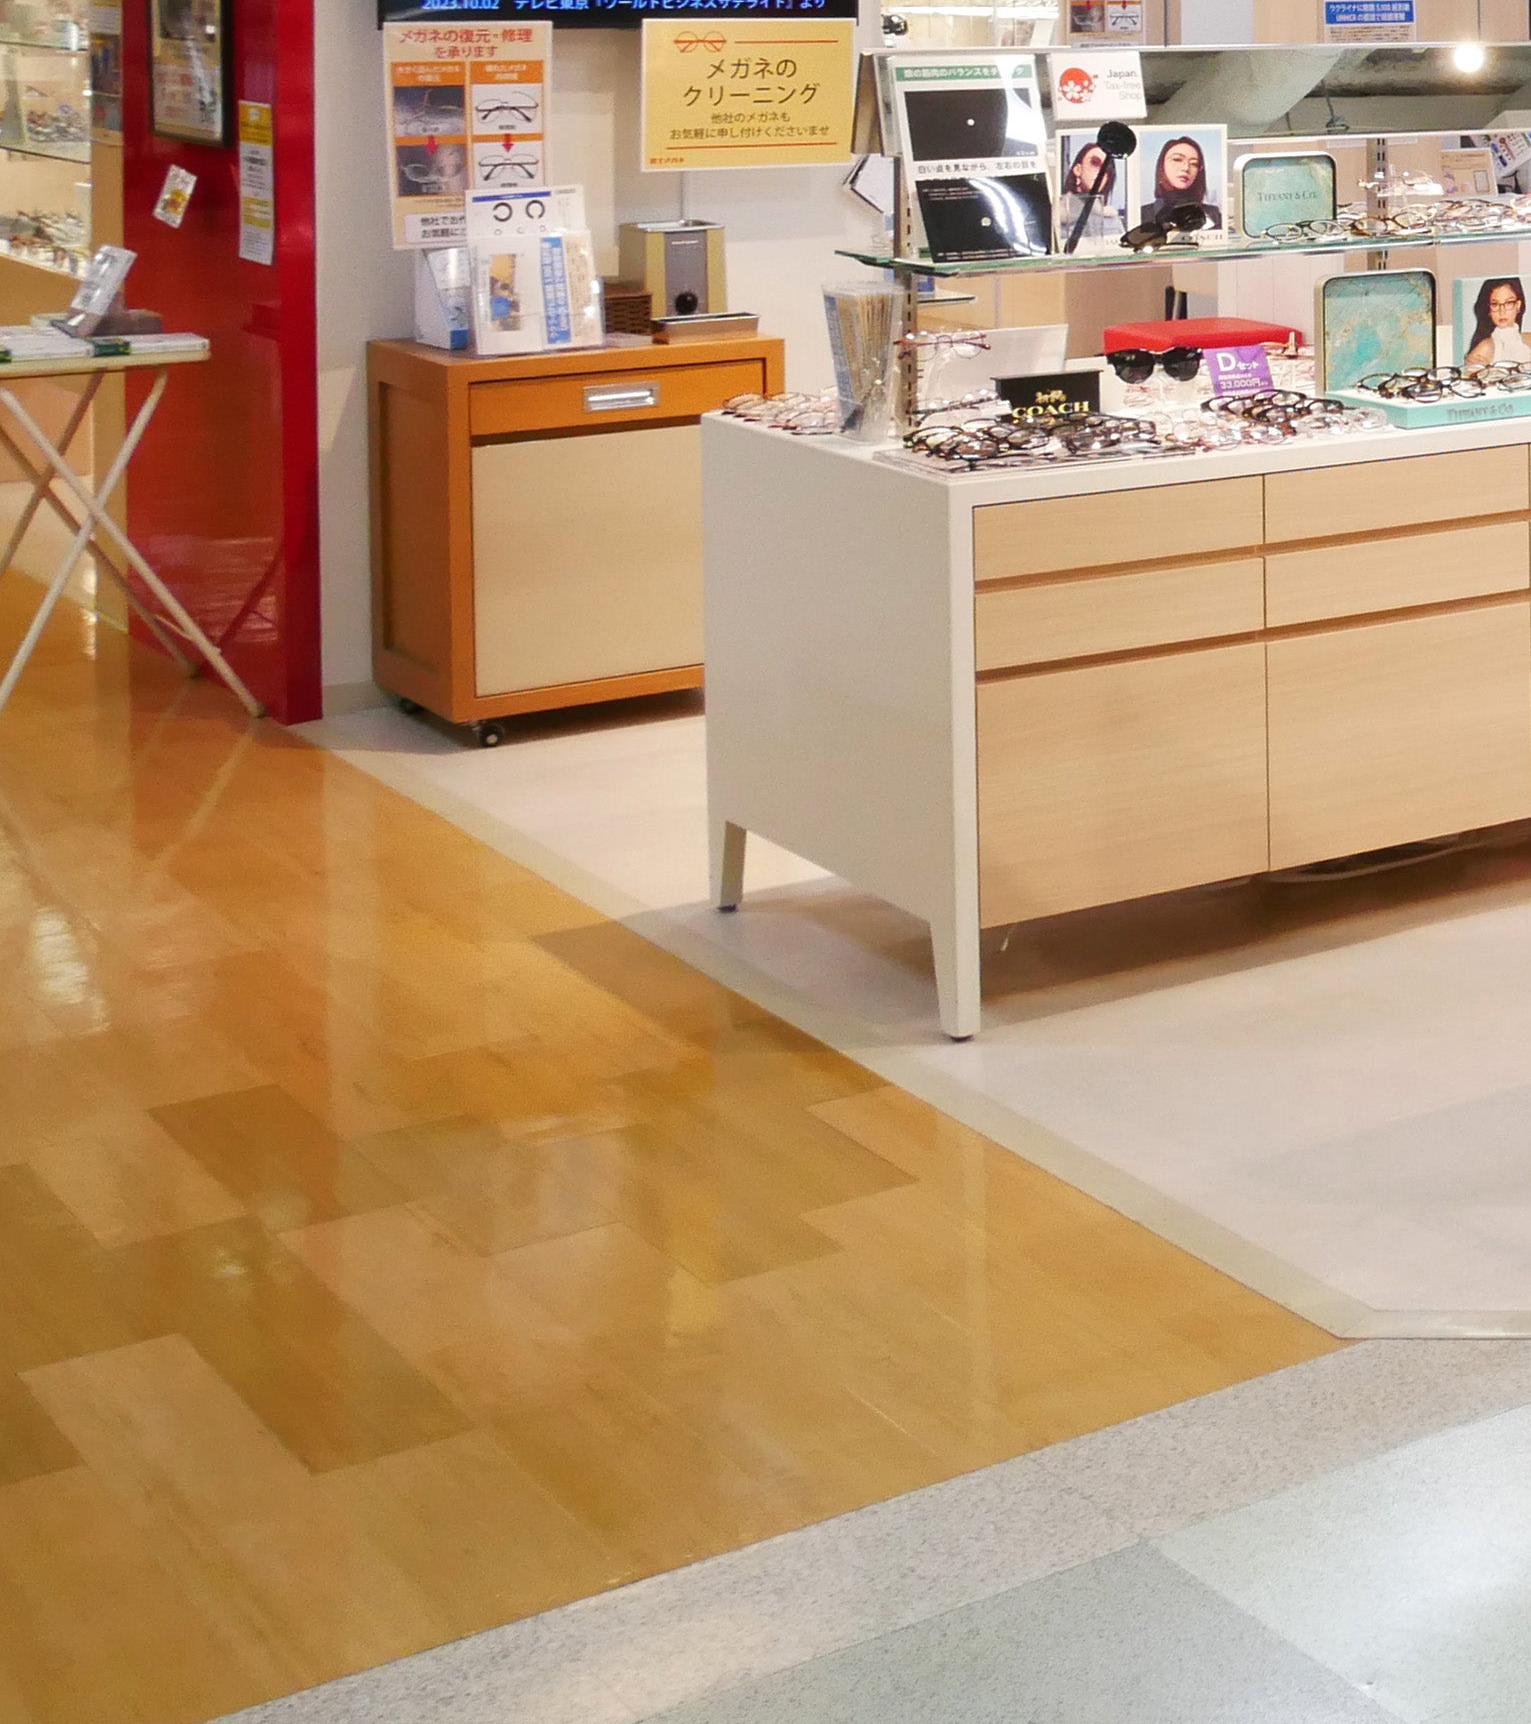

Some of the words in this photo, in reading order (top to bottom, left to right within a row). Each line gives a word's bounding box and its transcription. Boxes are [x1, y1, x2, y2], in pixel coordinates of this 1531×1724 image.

[706, 57, 798, 80] メガネの
[683, 82, 821, 106] クリーニング
[711, 111, 791, 123] 他社のメガネも
[670, 125, 830, 141] お気軽に申し付けくださいませ
[1012, 401, 1090, 419] COACH
